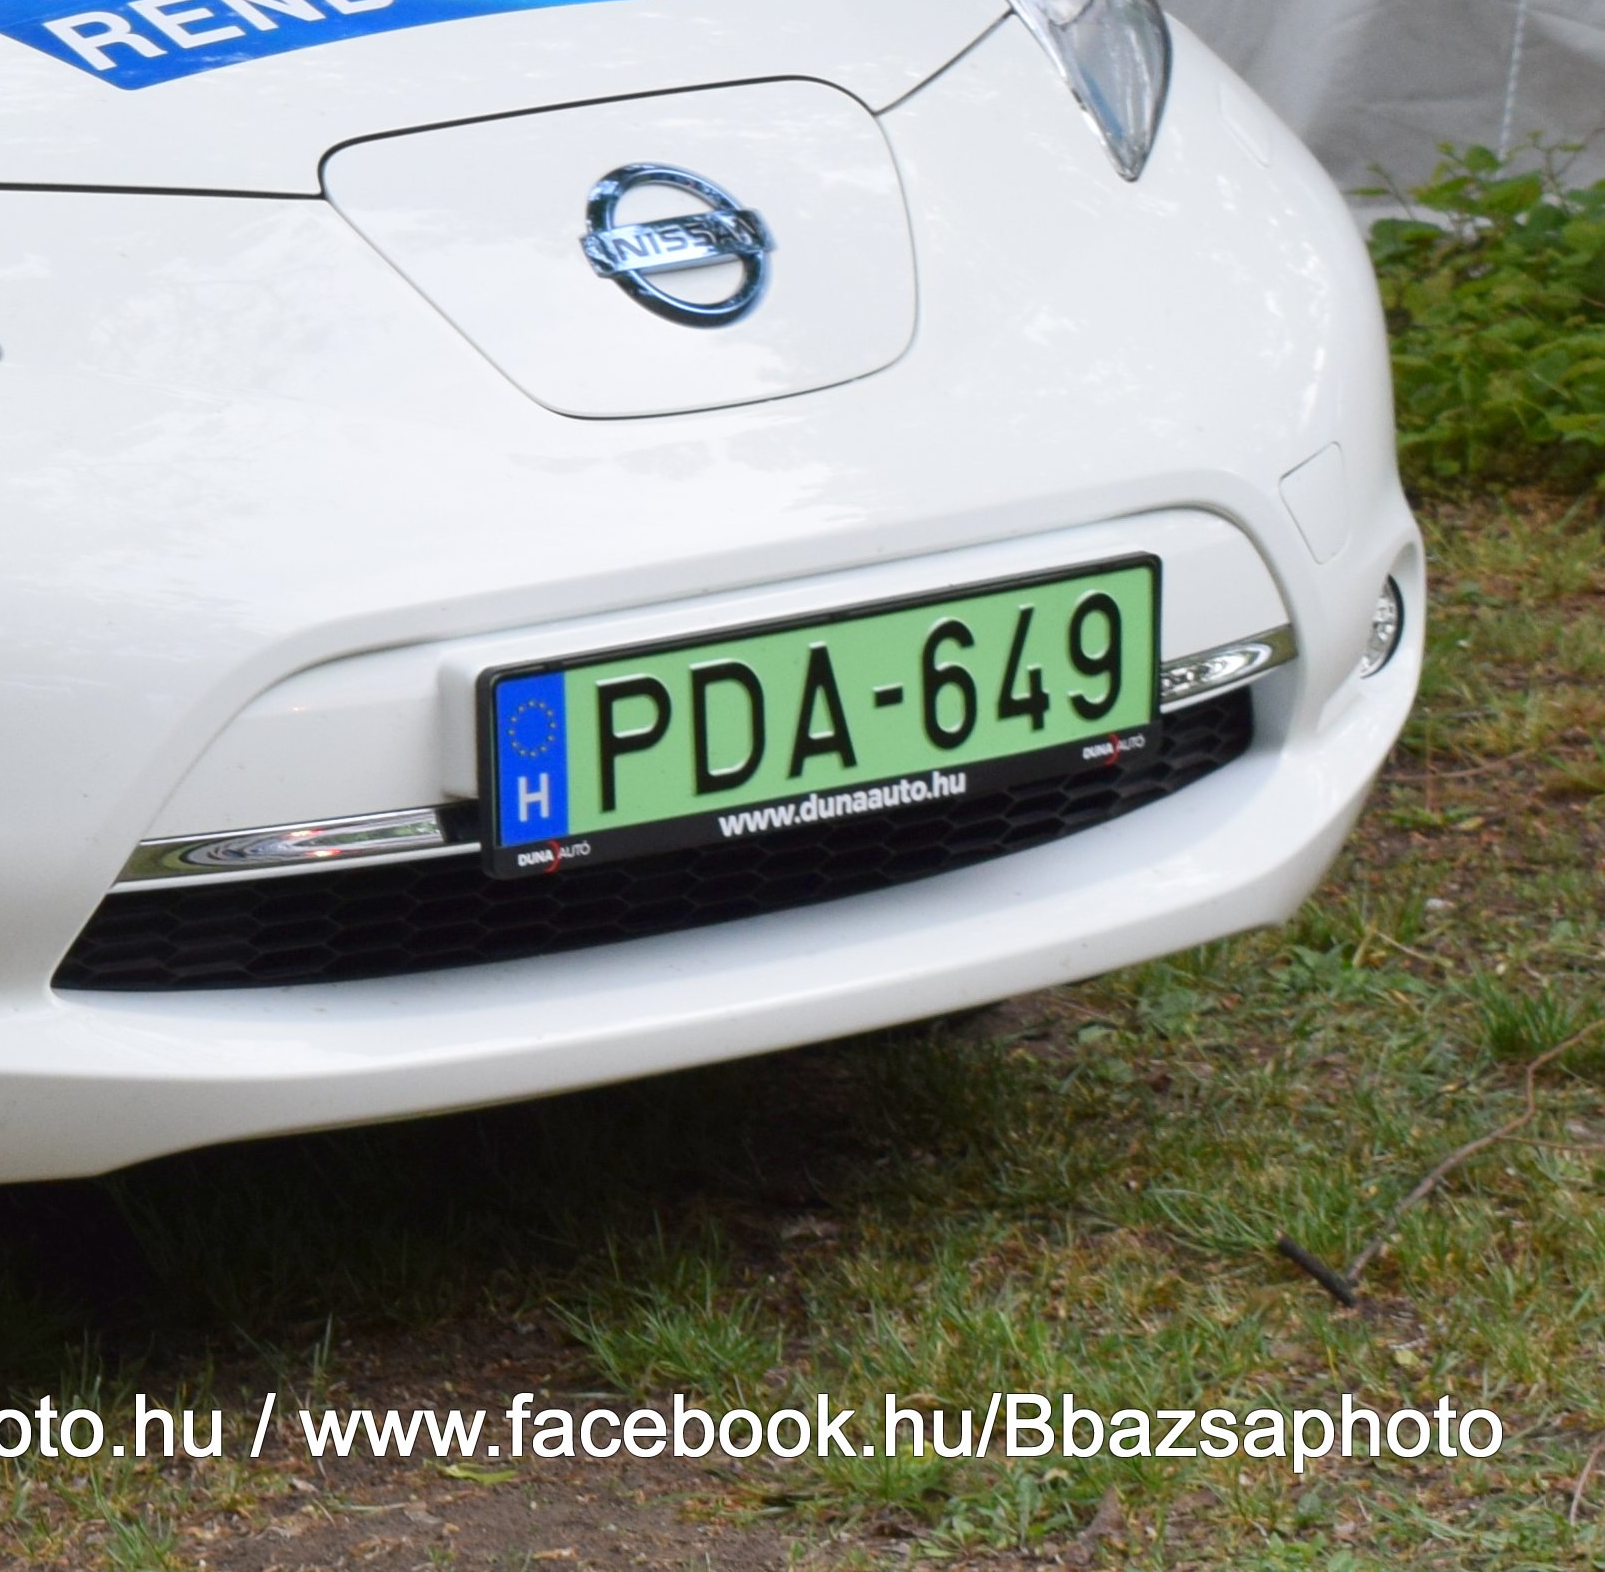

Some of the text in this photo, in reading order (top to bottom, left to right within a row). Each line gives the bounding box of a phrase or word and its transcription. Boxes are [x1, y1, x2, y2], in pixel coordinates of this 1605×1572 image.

[611, 214, 757, 263] NISSAN
[594, 589, 1124, 813] PDA-649
[1082, 742, 1114, 760] DUNA
[517, 773, 550, 823] H
[718, 770, 966, 837] www.dunaauto.hu
[517, 848, 554, 867] DUNA
